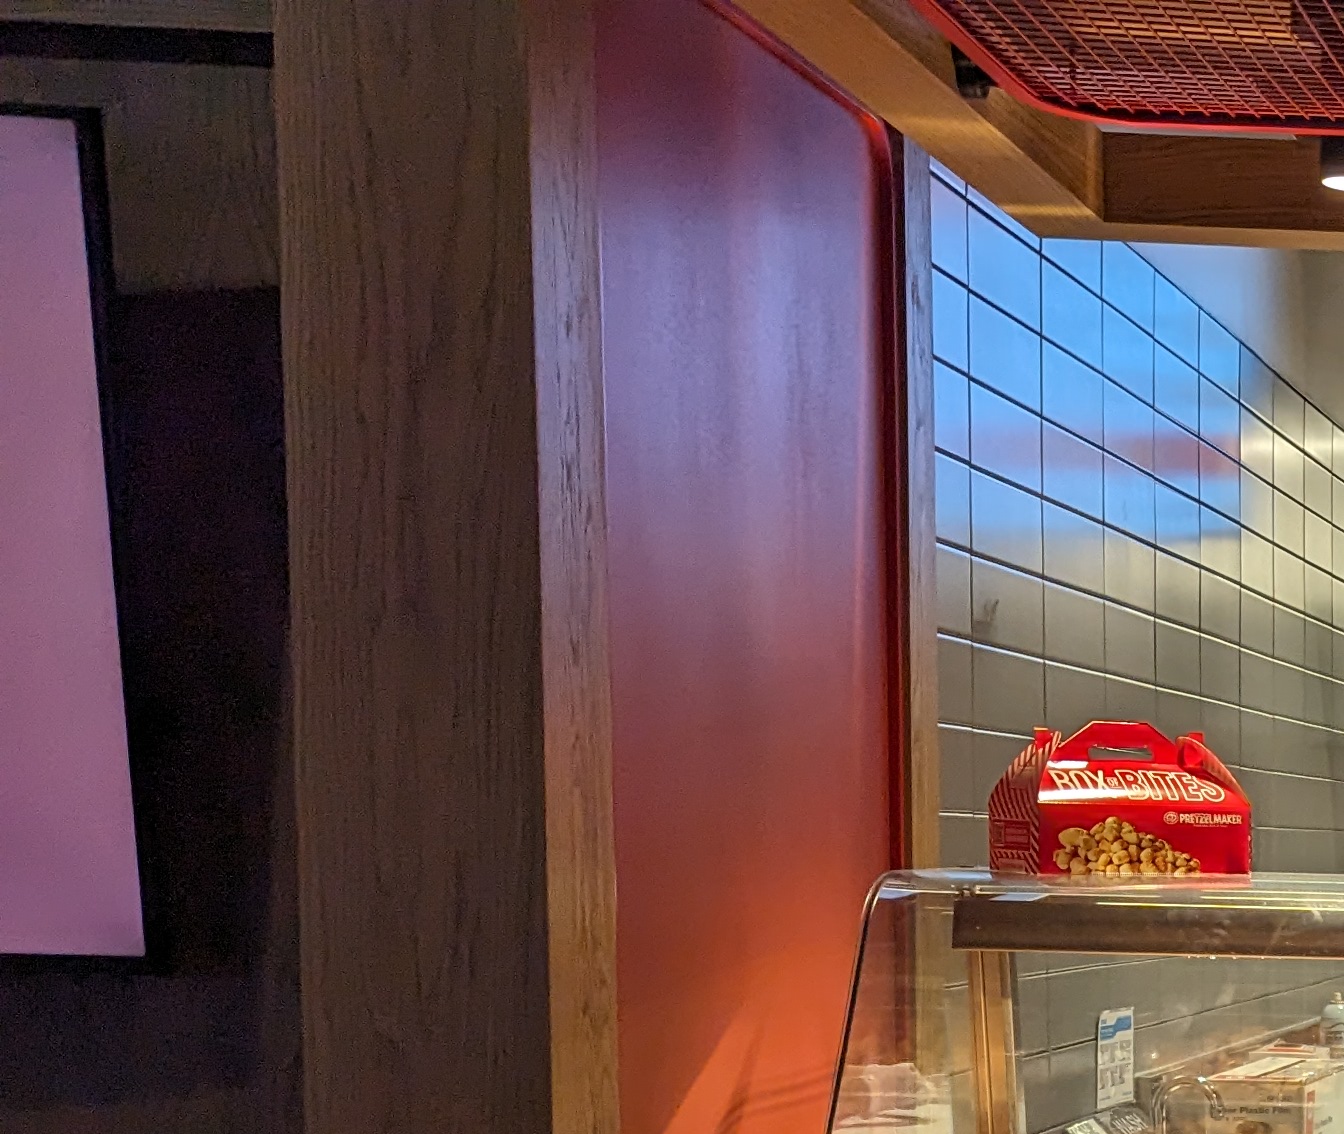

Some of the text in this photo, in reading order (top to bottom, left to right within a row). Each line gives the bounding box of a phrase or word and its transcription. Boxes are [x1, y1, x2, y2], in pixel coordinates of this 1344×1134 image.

[1048, 769, 1225, 802] BOX OF BITES
[1180, 813, 1242, 824] PRETZELMAKER
